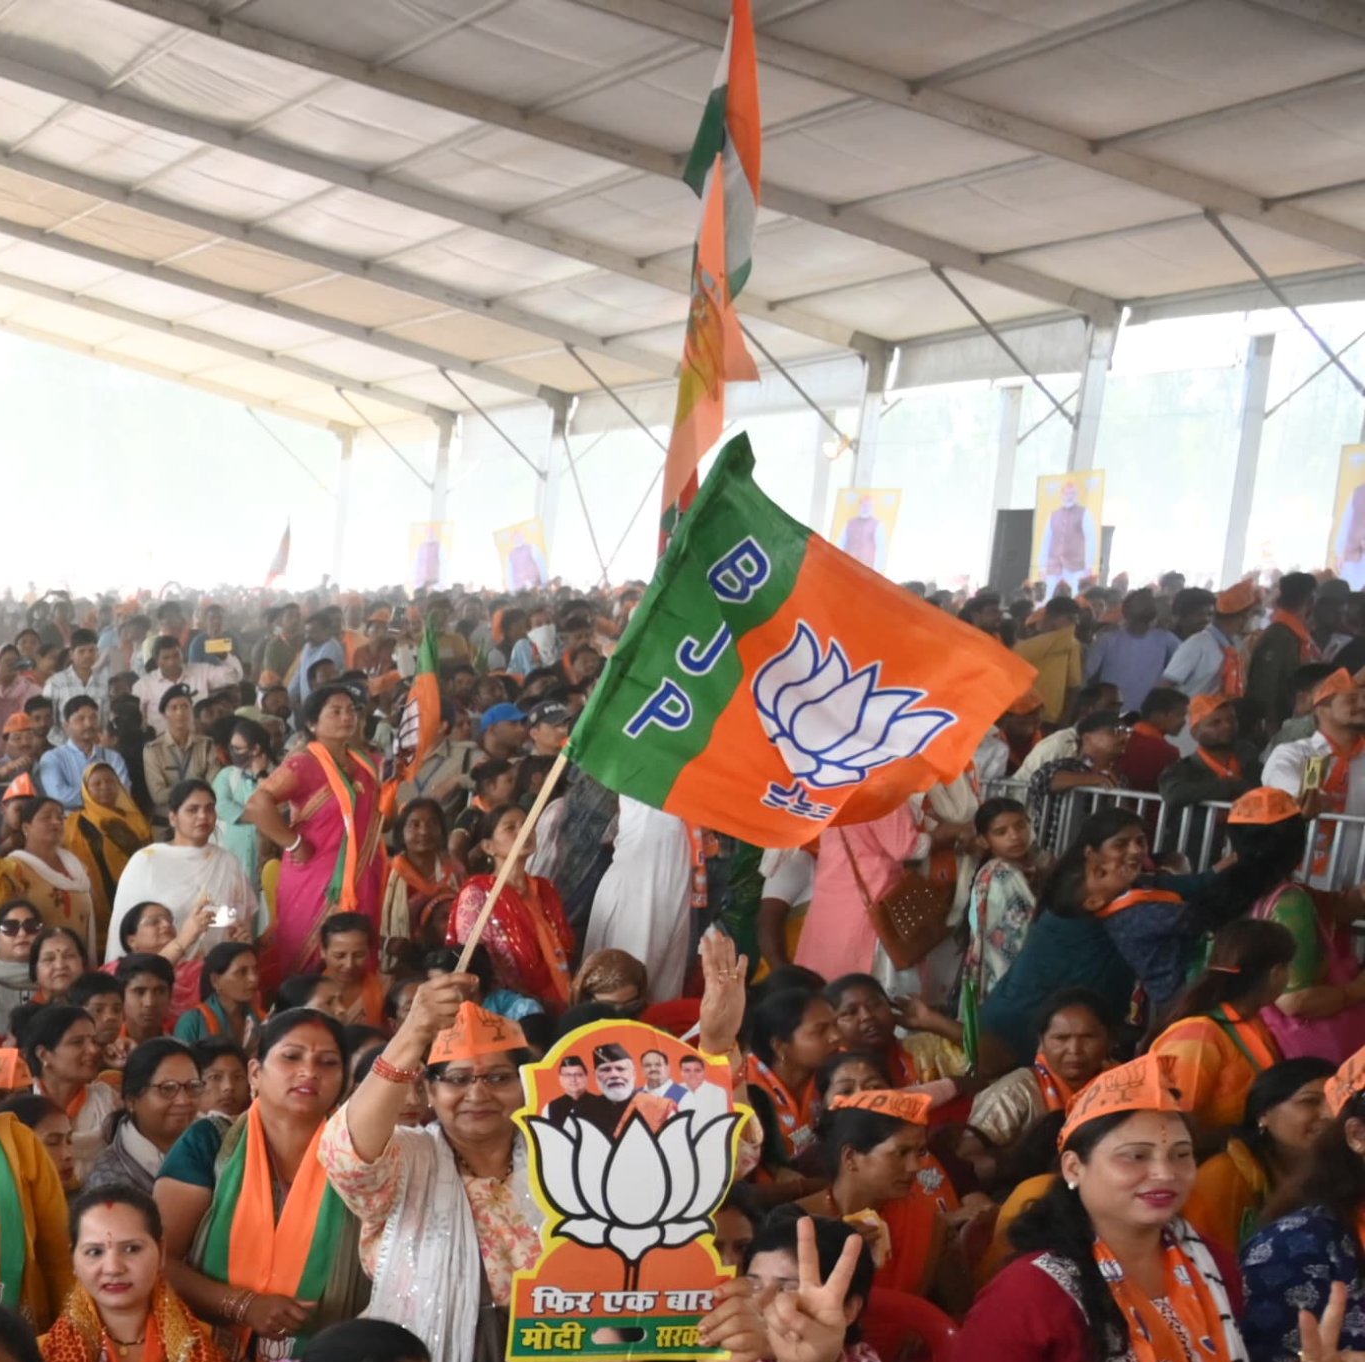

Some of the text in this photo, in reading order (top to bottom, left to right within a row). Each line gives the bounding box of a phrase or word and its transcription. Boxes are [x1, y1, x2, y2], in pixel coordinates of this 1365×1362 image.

[530, 1286, 715, 1314] फिर एक बार
[520, 1321, 702, 1351] मोदी सरक
